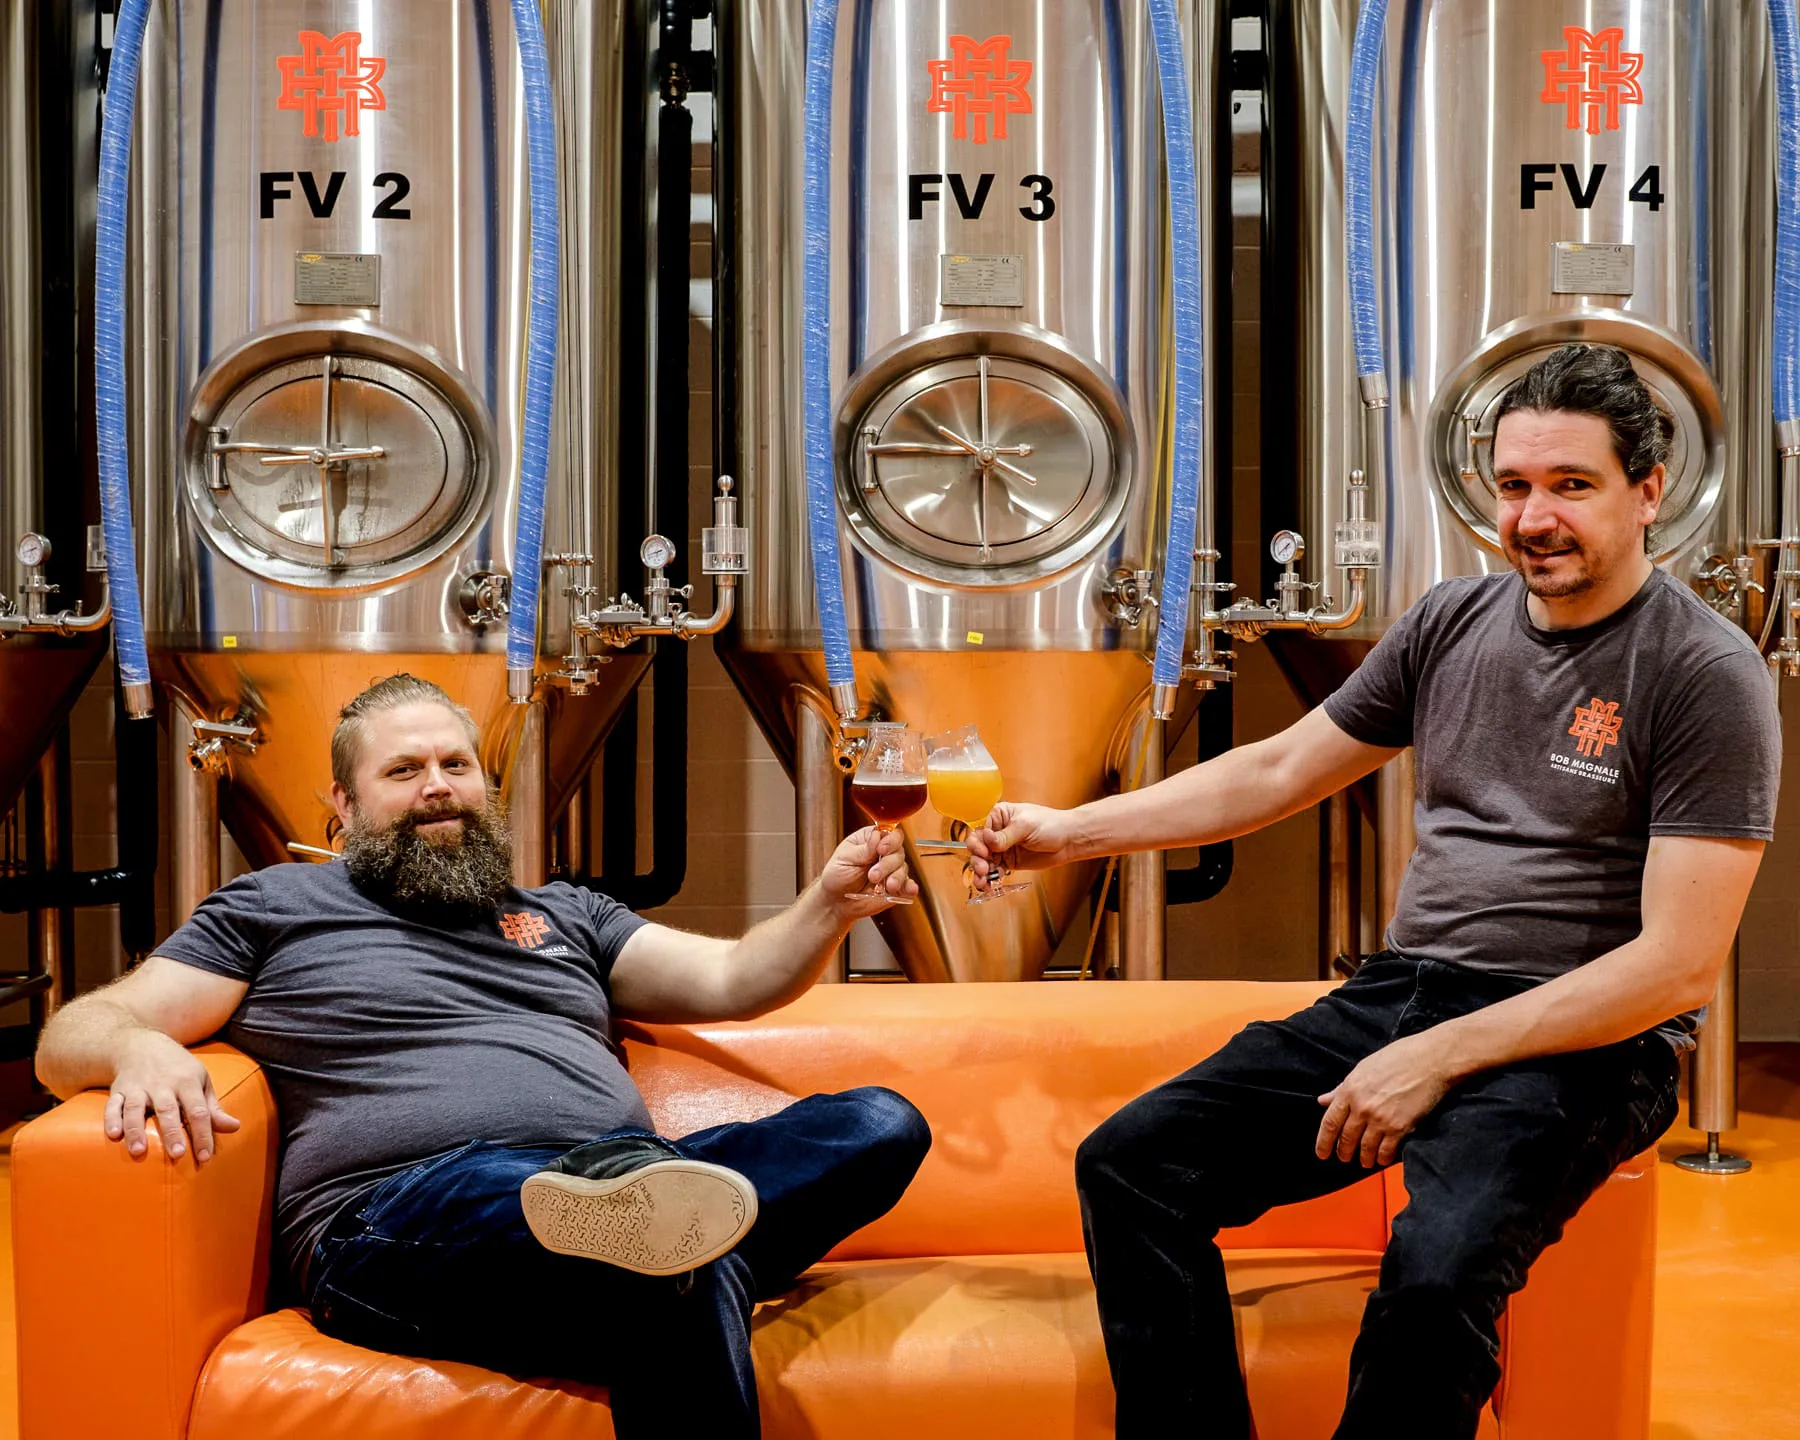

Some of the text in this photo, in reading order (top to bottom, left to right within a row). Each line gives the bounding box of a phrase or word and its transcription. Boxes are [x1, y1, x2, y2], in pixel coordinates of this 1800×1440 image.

[260, 171, 411, 220] FV 2
[909, 173, 1056, 221] FV 3
[1520, 163, 1664, 211] FV 4
[1550, 753, 1620, 778] BOB MAGNALE
[1578, 770, 1616, 784] BRASSEURS
